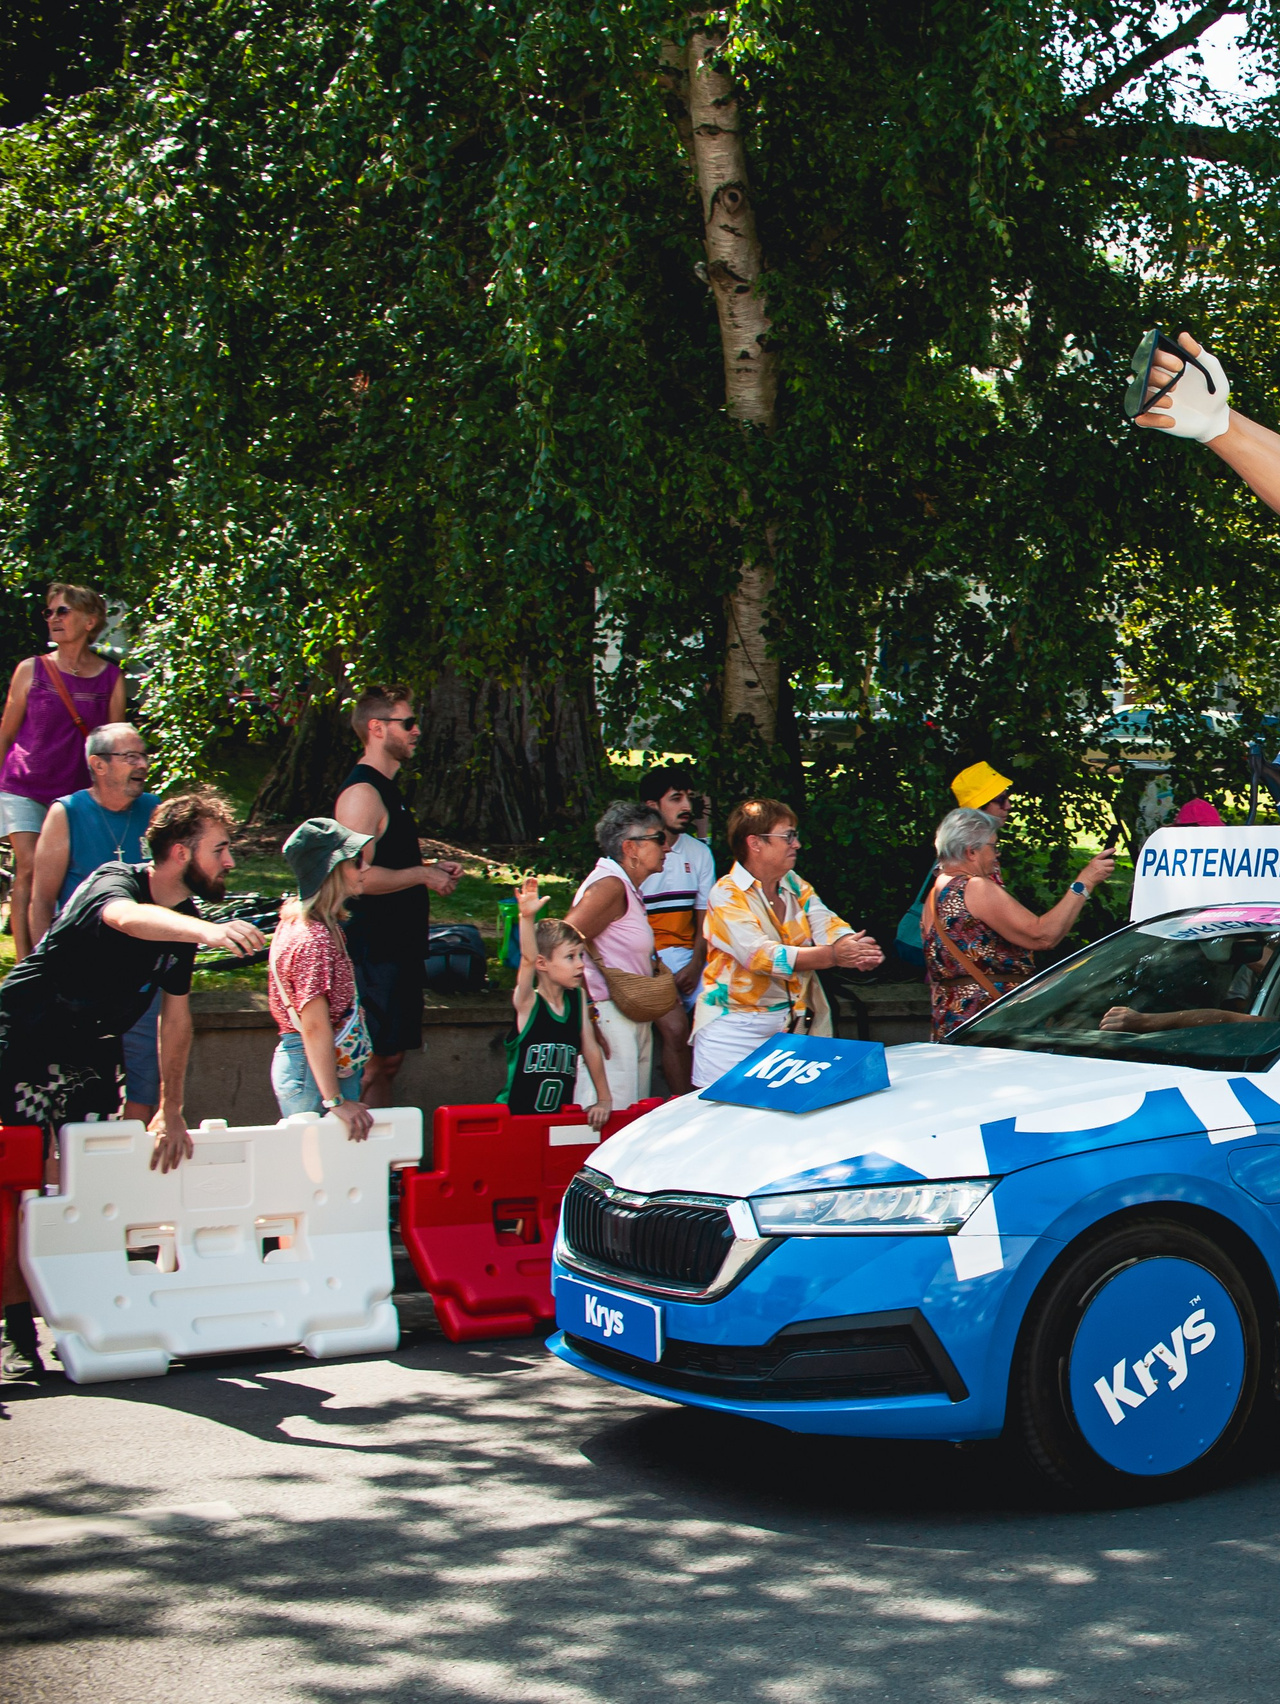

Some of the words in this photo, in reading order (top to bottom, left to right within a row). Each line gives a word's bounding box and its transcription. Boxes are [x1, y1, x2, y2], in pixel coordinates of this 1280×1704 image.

[523, 1043, 578, 1077] CELTIC
[744, 1049, 832, 1088] Krys
[534, 1078, 564, 1113] 0
[585, 1293, 625, 1337] Krys
[1093, 1308, 1216, 1426] Krys
